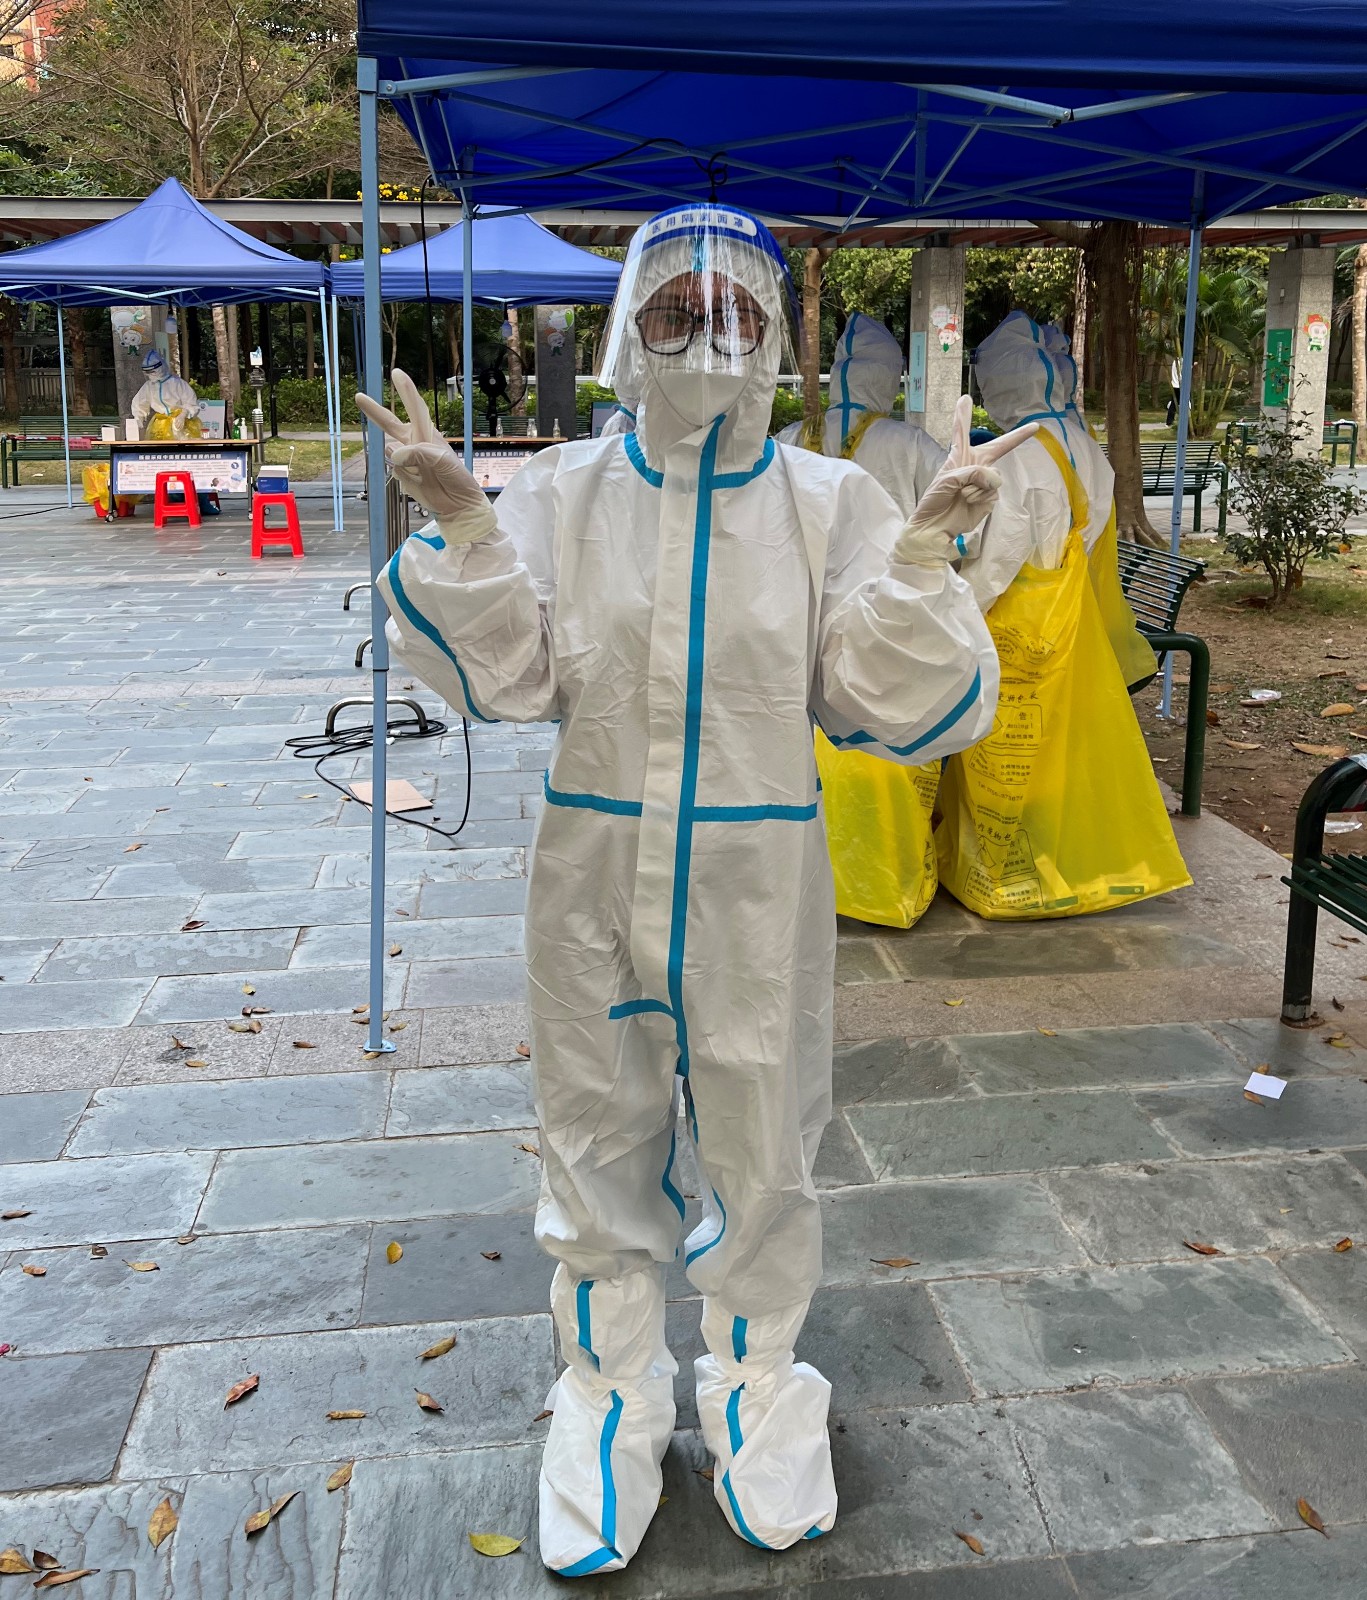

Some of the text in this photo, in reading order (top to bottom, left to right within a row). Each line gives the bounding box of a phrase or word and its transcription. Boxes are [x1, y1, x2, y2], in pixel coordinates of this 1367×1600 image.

[652, 213, 744, 234] 医用隔离面罩
